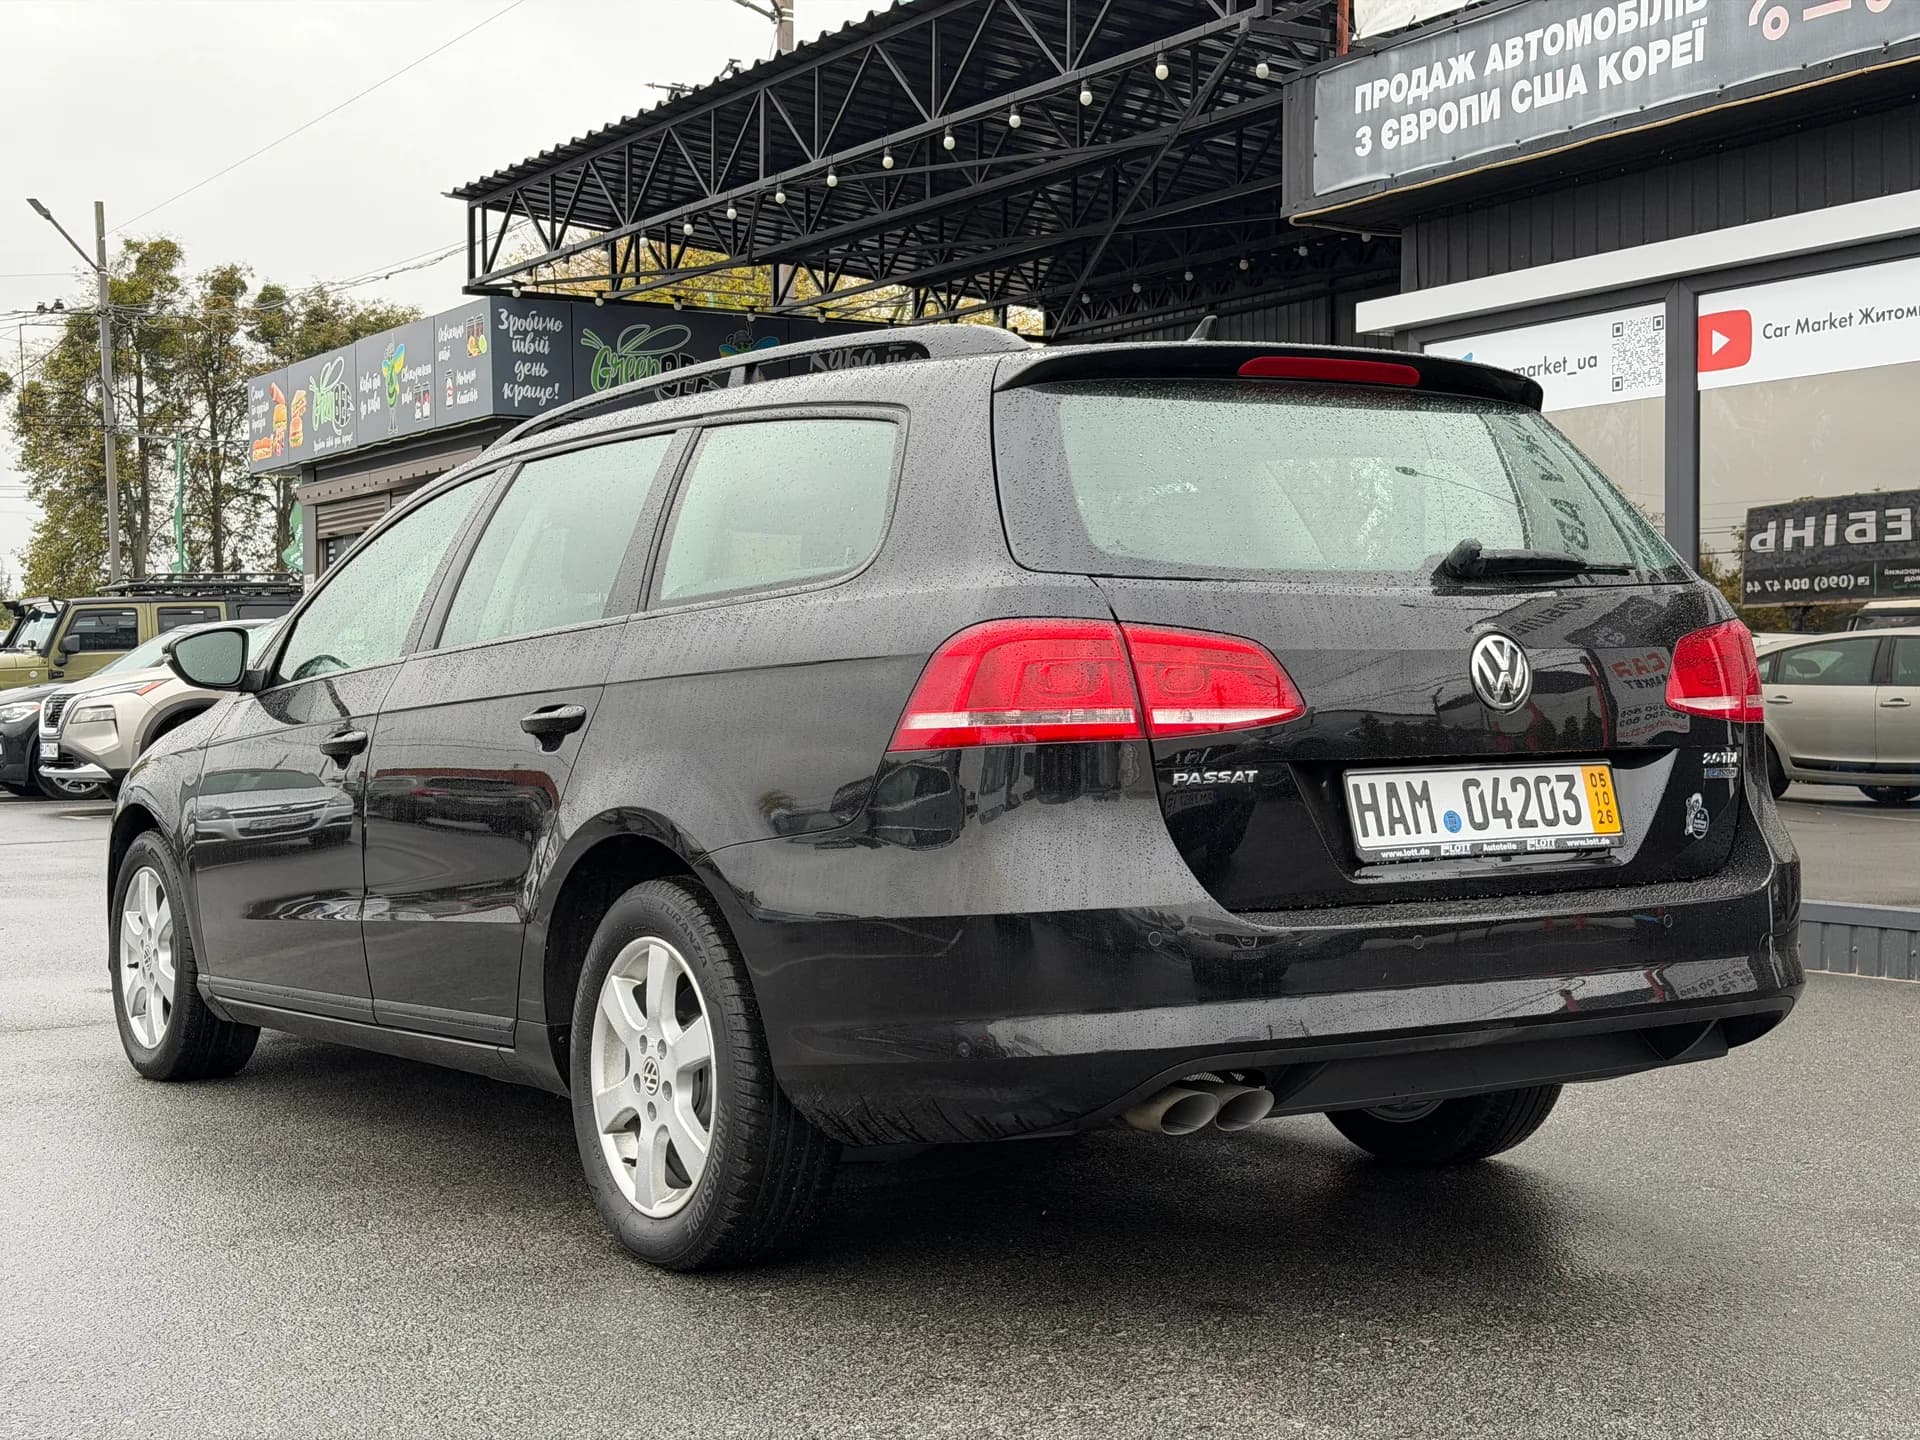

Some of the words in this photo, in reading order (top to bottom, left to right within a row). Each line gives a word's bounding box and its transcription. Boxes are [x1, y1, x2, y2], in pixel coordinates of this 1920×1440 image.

[1355, 50, 1476, 114] ПРОДАЖ
[1355, 126, 1372, 156] З
[1381, 88, 1500, 150] ЄВРОПИ
[1511, 63, 1588, 113] США
[1599, 16, 1707, 90] КОРЕЇ
[498, 308, 564, 338] Зробимо
[1763, 323, 1790, 339] Car
[1795, 312, 1853, 335] Market
[1858, 304, 1920, 326] Житом
[512, 332, 551, 354] твій
[514, 360, 549, 382] день
[1173, 770, 1258, 786] PASSAT
[1590, 772, 1607, 788] 05
[1352, 780, 1438, 838] HAM
[1462, 774, 1582, 831] 04203
[1595, 793, 1610, 806] 10
[1597, 809, 1613, 824] 26
[1381, 847, 1430, 858] www.lott.de
[1567, 837, 1610, 847] www.lott.de
